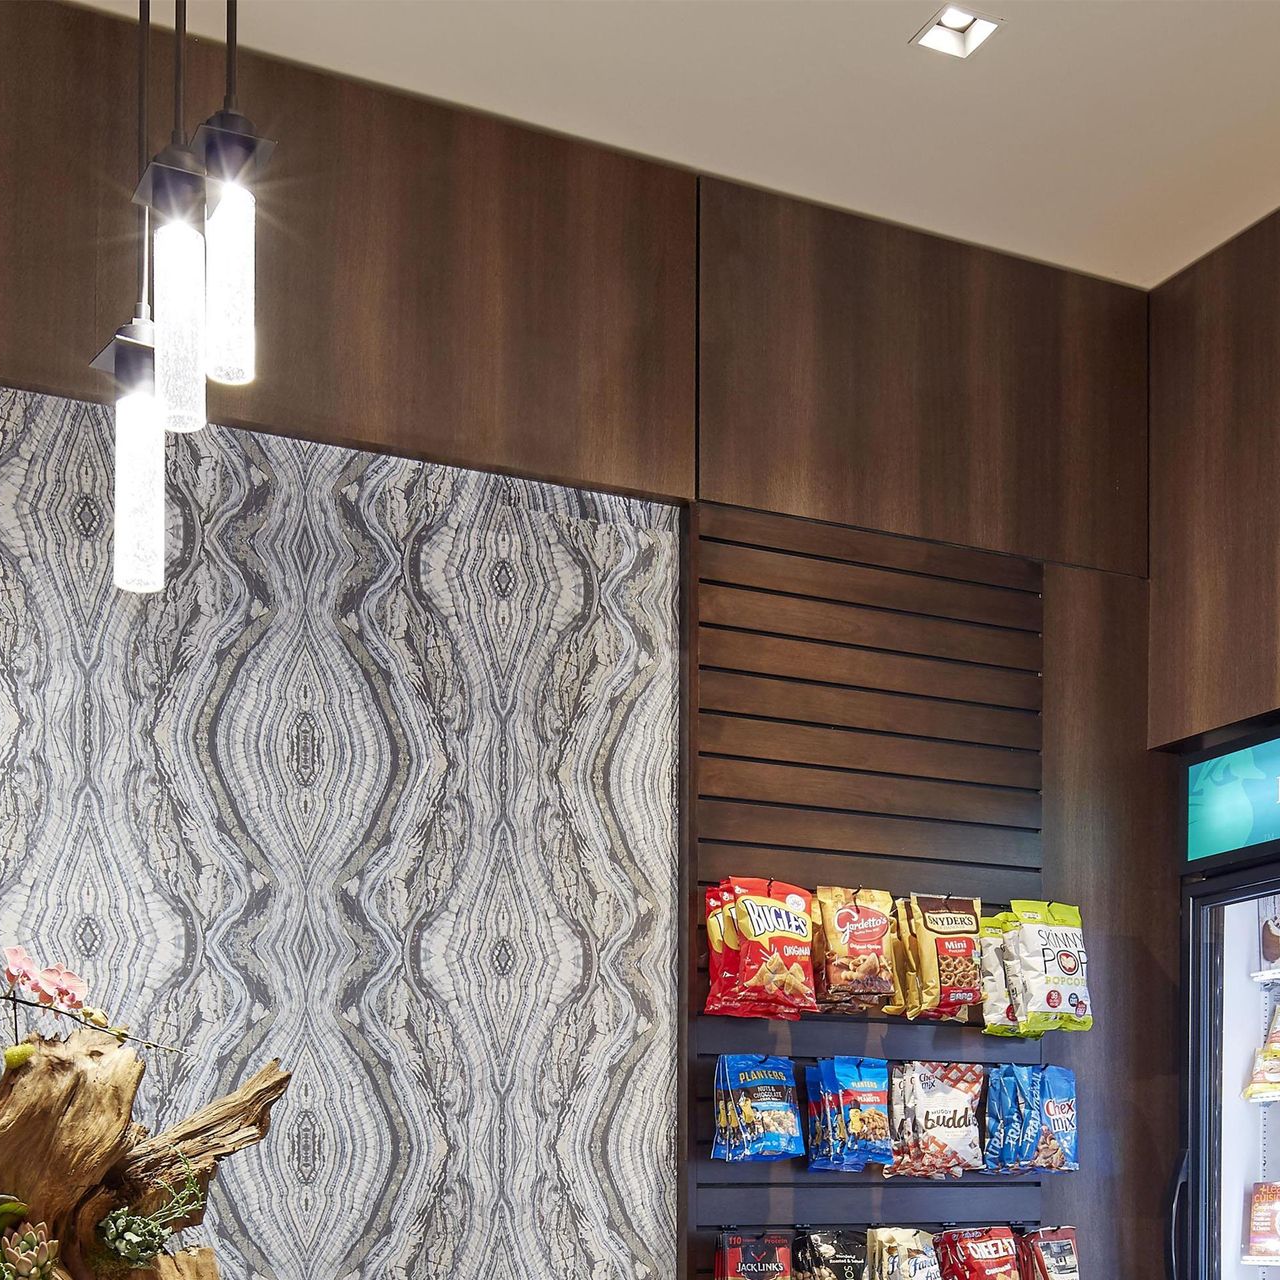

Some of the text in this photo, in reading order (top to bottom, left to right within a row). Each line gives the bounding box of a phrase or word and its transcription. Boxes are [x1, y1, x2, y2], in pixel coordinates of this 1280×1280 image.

[743, 898, 809, 938] BUGLES
[835, 908, 888, 944] Gardetto's
[944, 940, 967, 949] Mini
[739, 1070, 786, 1083] PLANTERS
[851, 1081, 878, 1089] PLANTERS
[1045, 1099, 1074, 1116] Chex
[1052, 1117, 1075, 1132] mix
[736, 1263, 757, 1273] JACK
